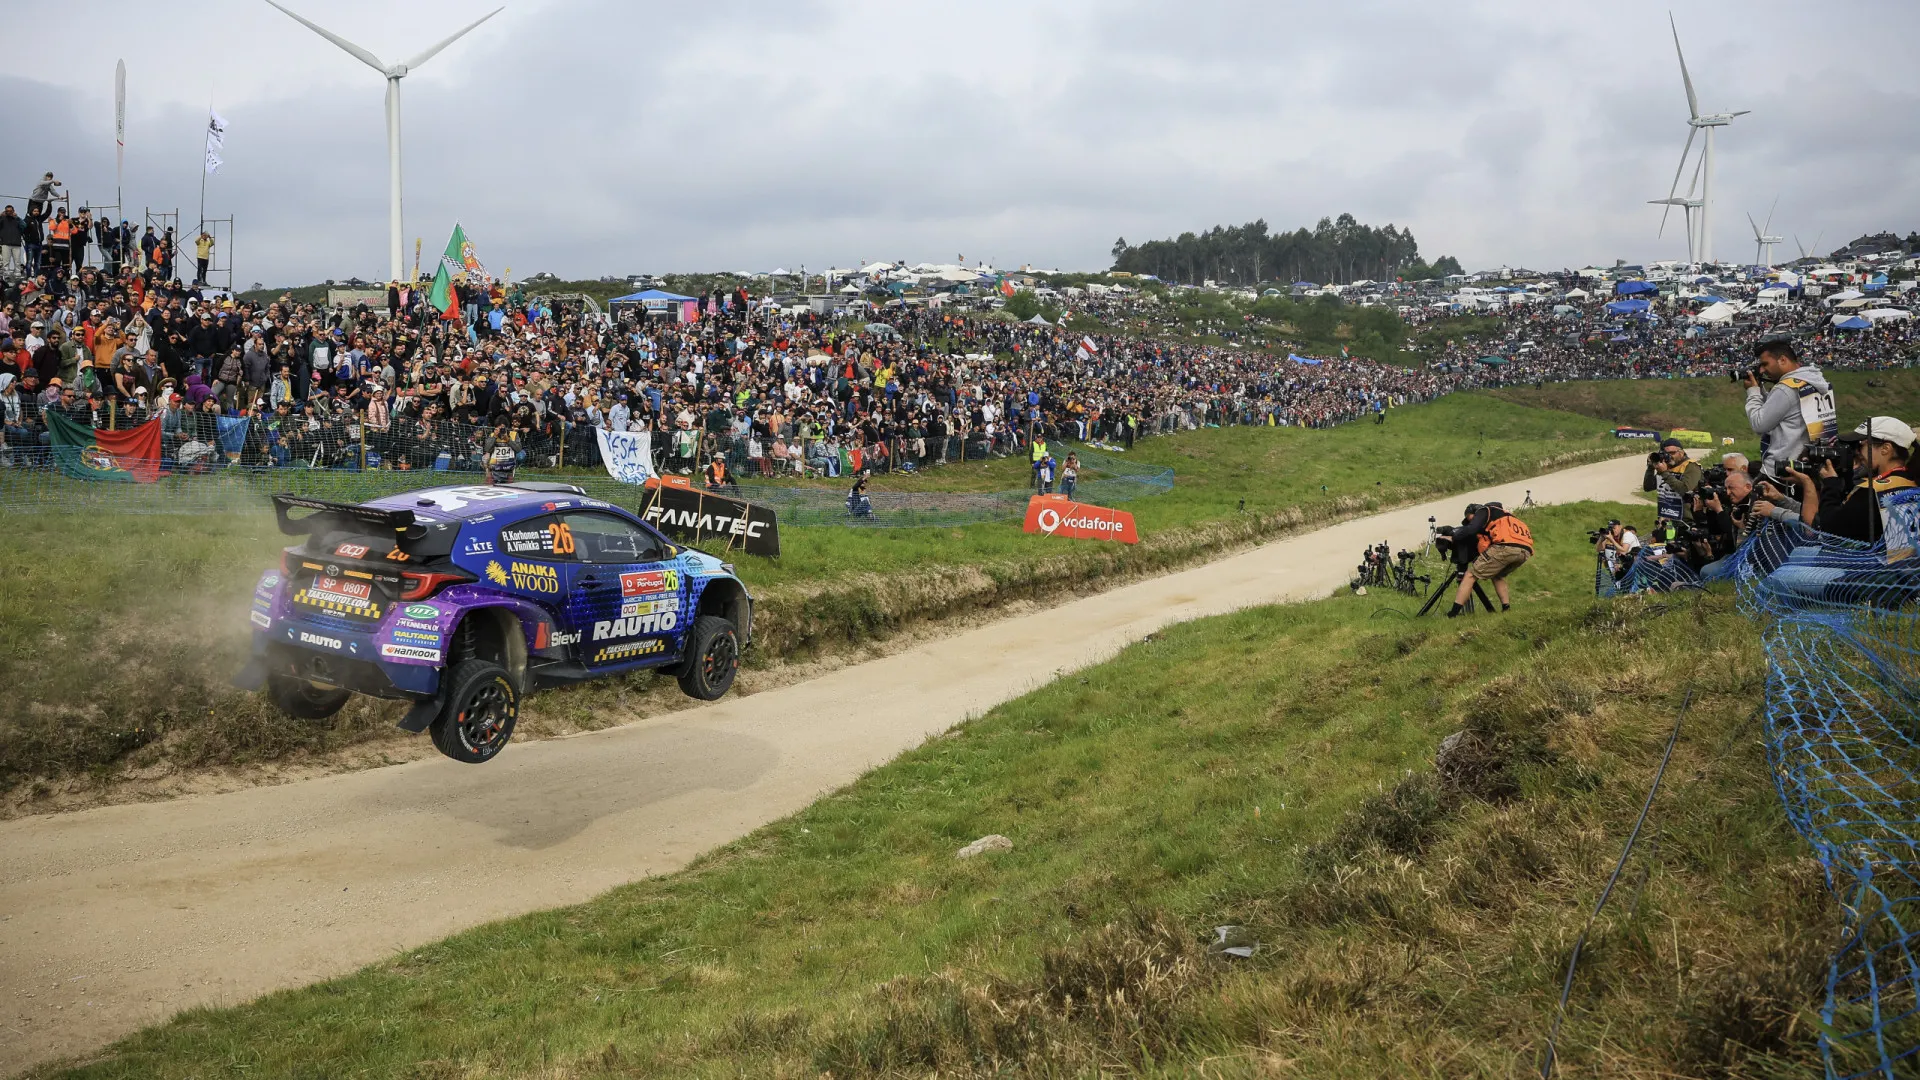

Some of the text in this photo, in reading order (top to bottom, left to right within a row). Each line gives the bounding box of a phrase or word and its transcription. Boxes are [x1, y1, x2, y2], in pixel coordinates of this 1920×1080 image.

[644, 505, 766, 539] FANATEC
[1062, 516, 1123, 532] vodafone
[472, 541, 494, 551] KTE
[549, 523, 575, 554] 26
[511, 561, 558, 579] ANAIKA
[322, 578, 367, 595] SP 0807
[511, 573, 559, 594] WOOD
[663, 570, 679, 592] 26
[307, 589, 370, 609] TAKSIAUTOT.COM
[592, 612, 677, 641] RAUTIO
[300, 631, 342, 650] RAUTIO
[394, 630, 440, 642] RAUTAMO
[550, 630, 582, 647] Sievi
[606, 639, 657, 654] TAKSIAUTOT.COM
